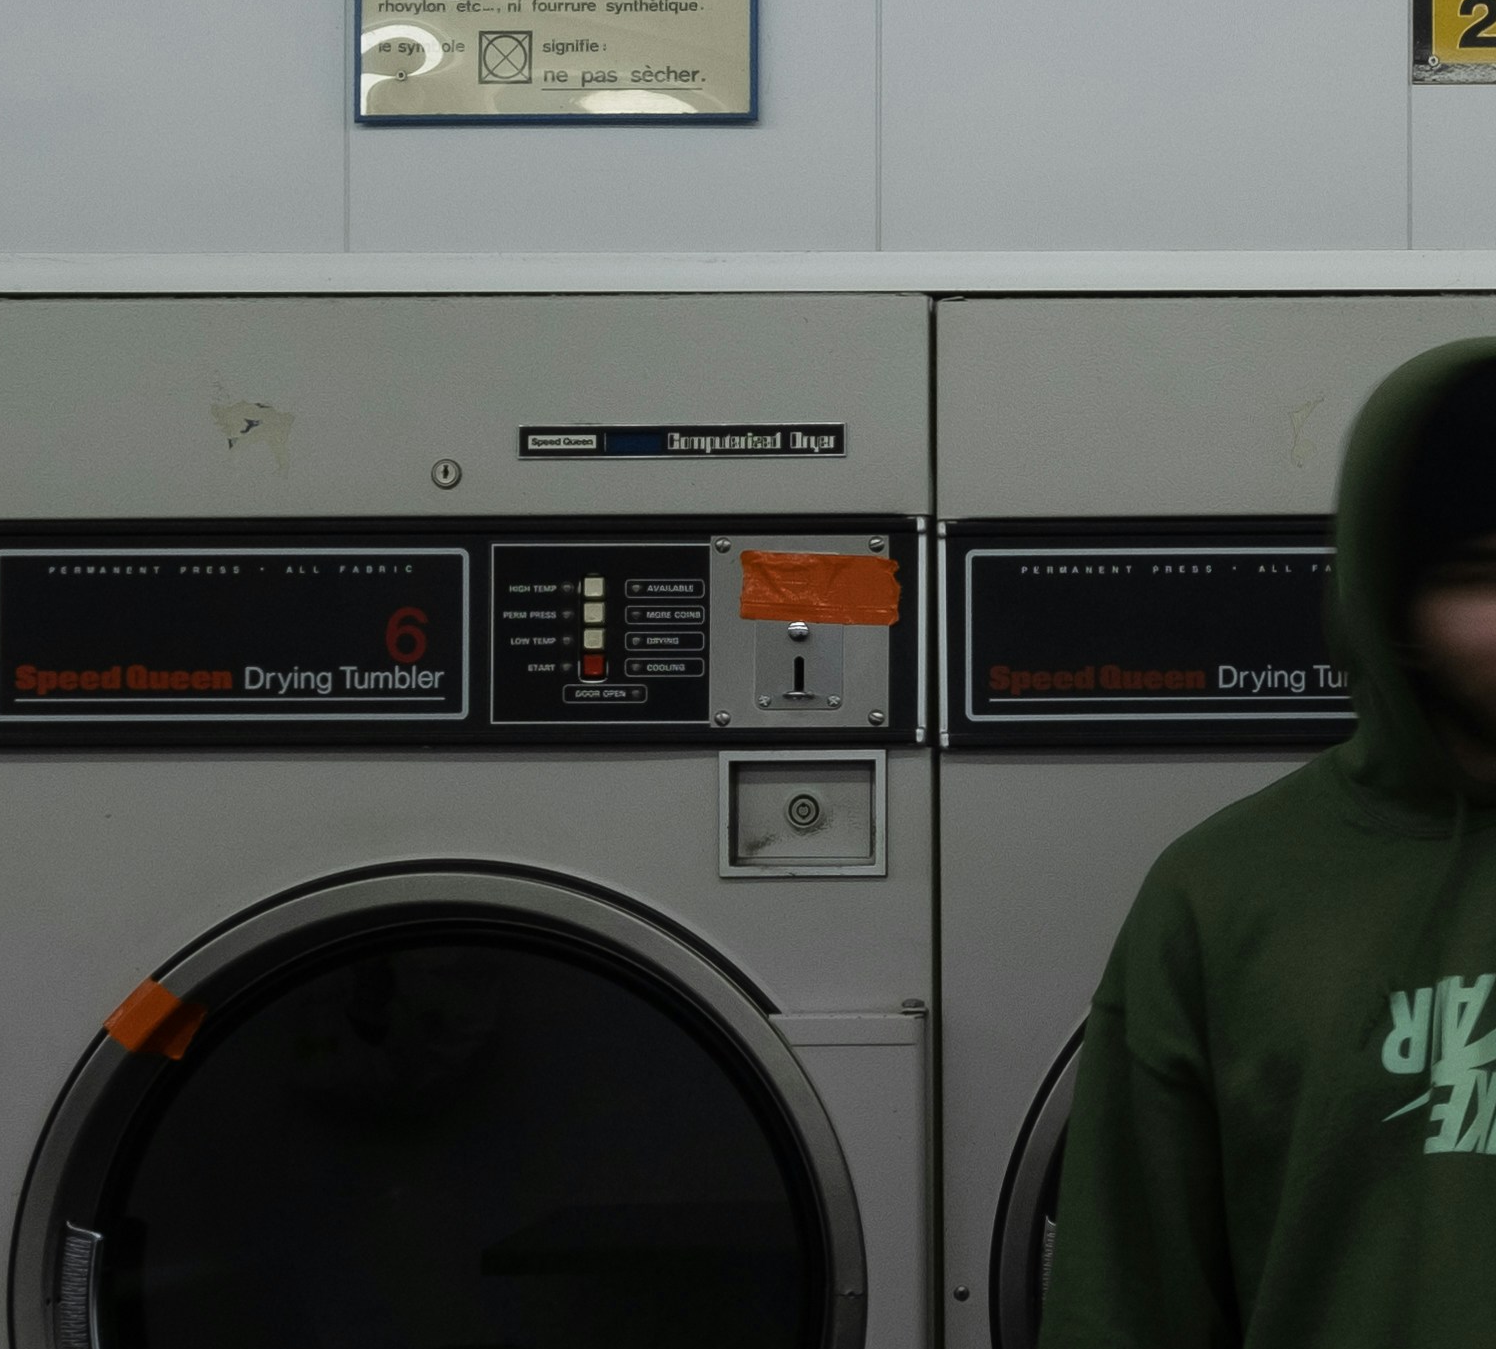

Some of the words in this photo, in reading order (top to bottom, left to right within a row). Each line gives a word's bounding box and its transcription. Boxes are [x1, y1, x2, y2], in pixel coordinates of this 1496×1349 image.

[544, 68, 568, 83] ne
[581, 68, 617, 87] pas
[180, 566, 241, 575] PRESS
[286, 565, 320, 574] ALL
[385, 607, 428, 663] 6
[15, 664, 121, 695] Speed
[127, 665, 232, 690] Queen
[245, 666, 332, 694] Drying
[339, 665, 445, 690] Tumbler
[989, 665, 1095, 695] Speed
[1099, 664, 1206, 690] Queen
[1218, 664, 1306, 693] Drying
